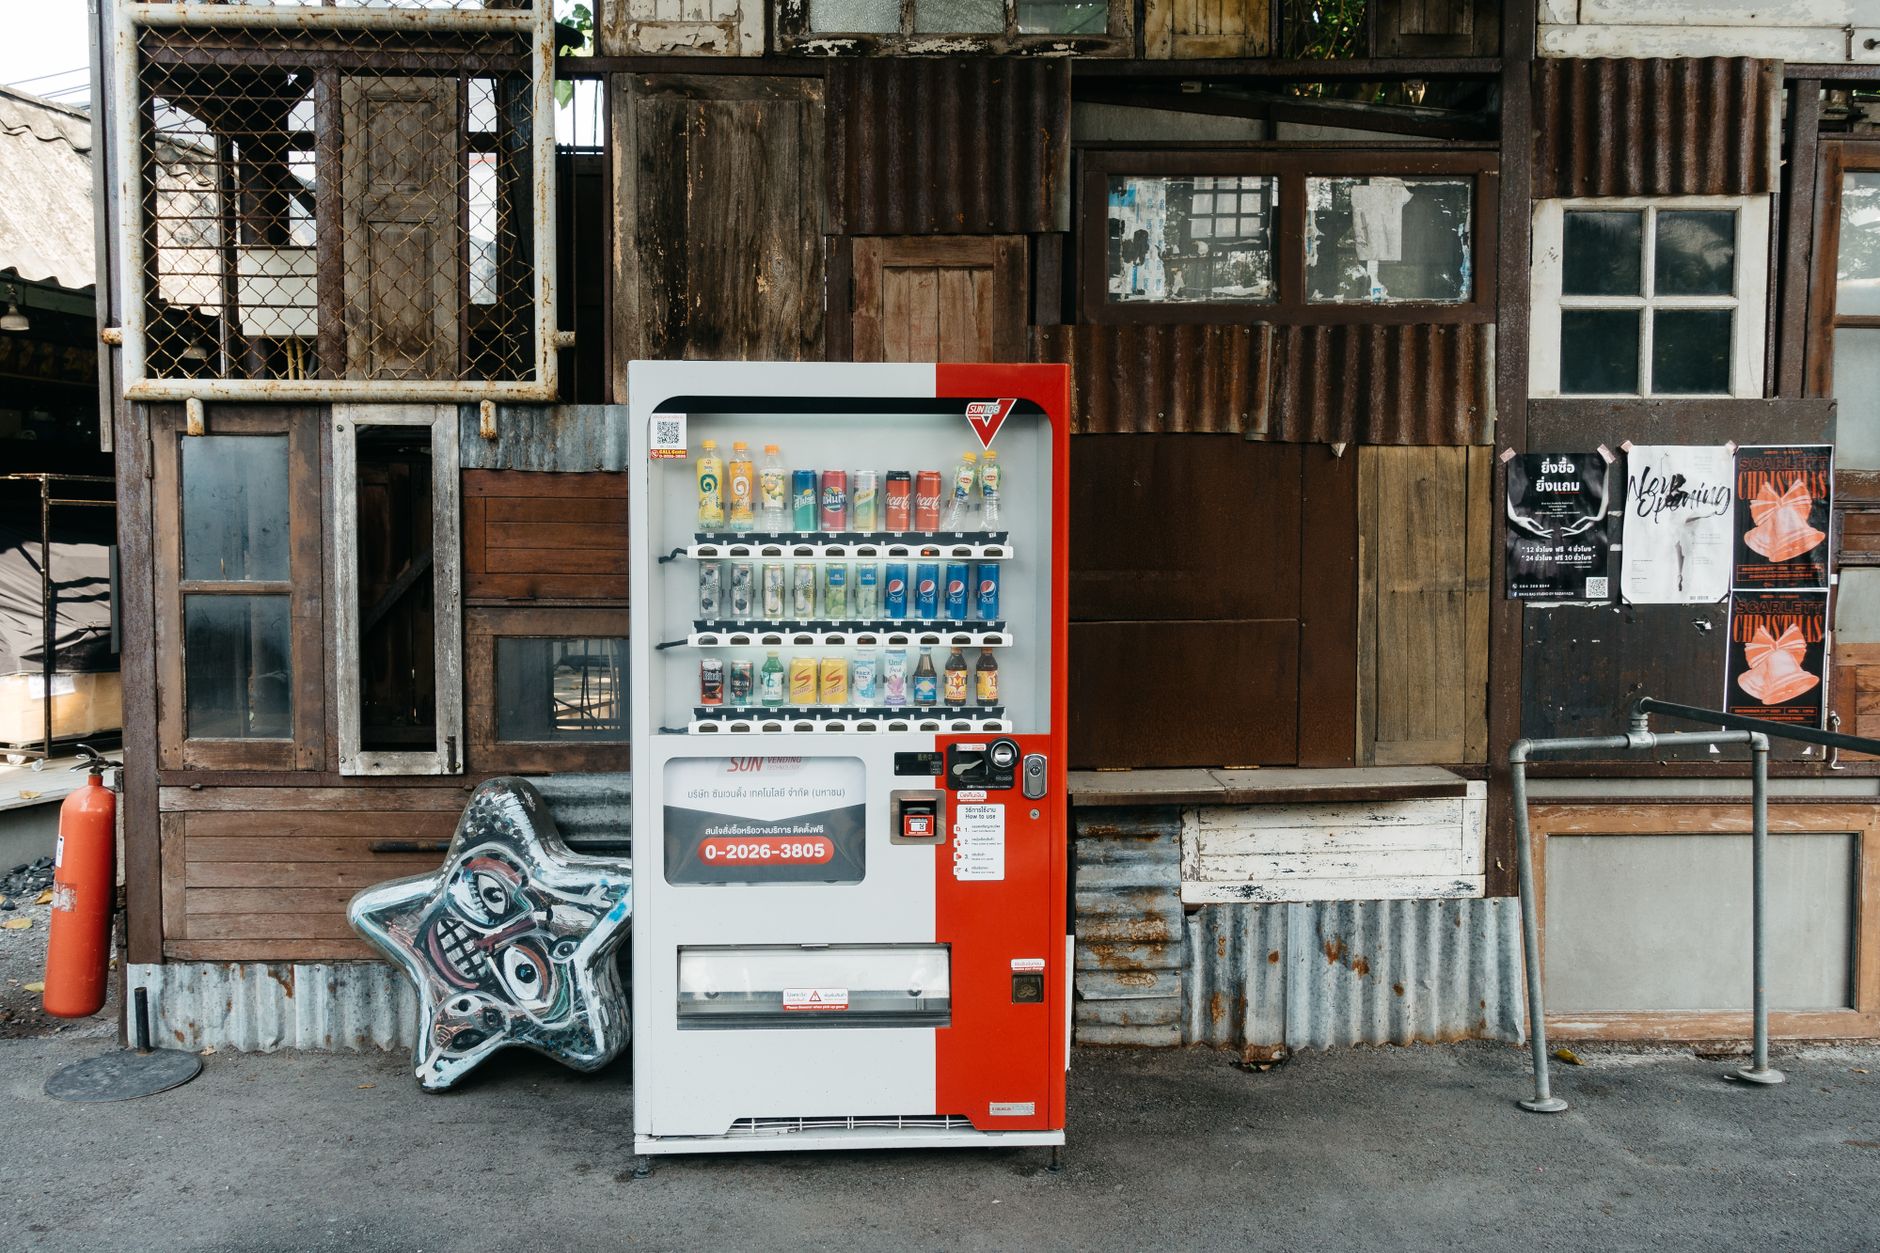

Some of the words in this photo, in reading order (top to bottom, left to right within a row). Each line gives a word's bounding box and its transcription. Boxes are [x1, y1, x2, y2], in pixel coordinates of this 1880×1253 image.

[1541, 456, 1576, 474] ยิ่งซื้อ
[1740, 455, 1828, 470] SCARLETT
[1535, 475, 1580, 492] ยิ่งแถม
[1535, 545, 1553, 553] ชั่วโมง
[1573, 544, 1592, 552] ชั่วโมง
[1535, 553, 1552, 561] ชั่วโมง
[1736, 600, 1824, 613] SCARLETT
[727, 757, 764, 772] SUN
[687, 787, 710, 799] บริษัท
[712, 786, 747, 799] ซันเวนดิ้ง
[749, 788, 785, 798] เทคโนโลยี
[788, 787, 809, 798] จำกัด
[811, 787, 846, 799] (มหาชน)
[705, 823, 792, 835] สนใจสั่งซื้อหรือวางบริการ
[793, 822, 824, 834] ติดตั้งฟรี
[705, 843, 825, 860] 0-2026-3805
